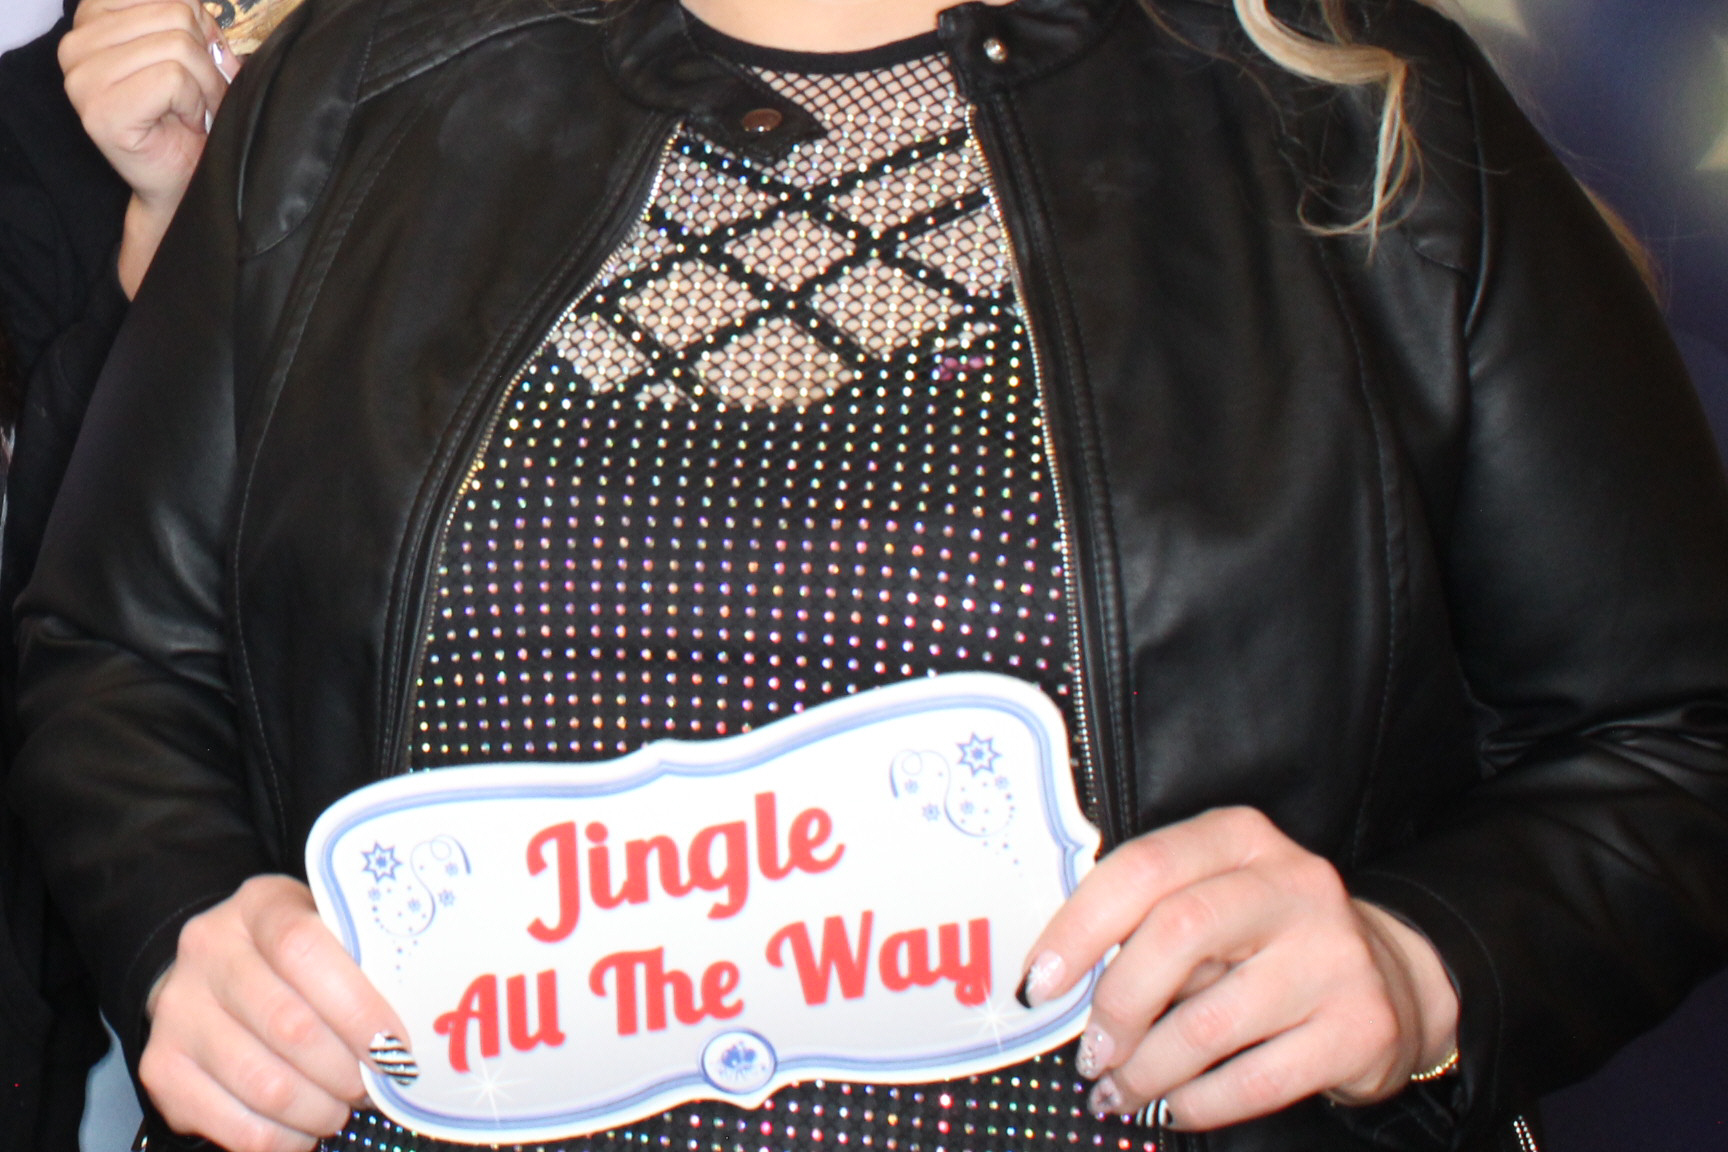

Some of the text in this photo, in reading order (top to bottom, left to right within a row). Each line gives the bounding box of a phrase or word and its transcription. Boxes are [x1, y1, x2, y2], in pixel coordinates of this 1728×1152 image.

[526, 791, 845, 943] Jingle
[433, 910, 991, 1073] All The Way
